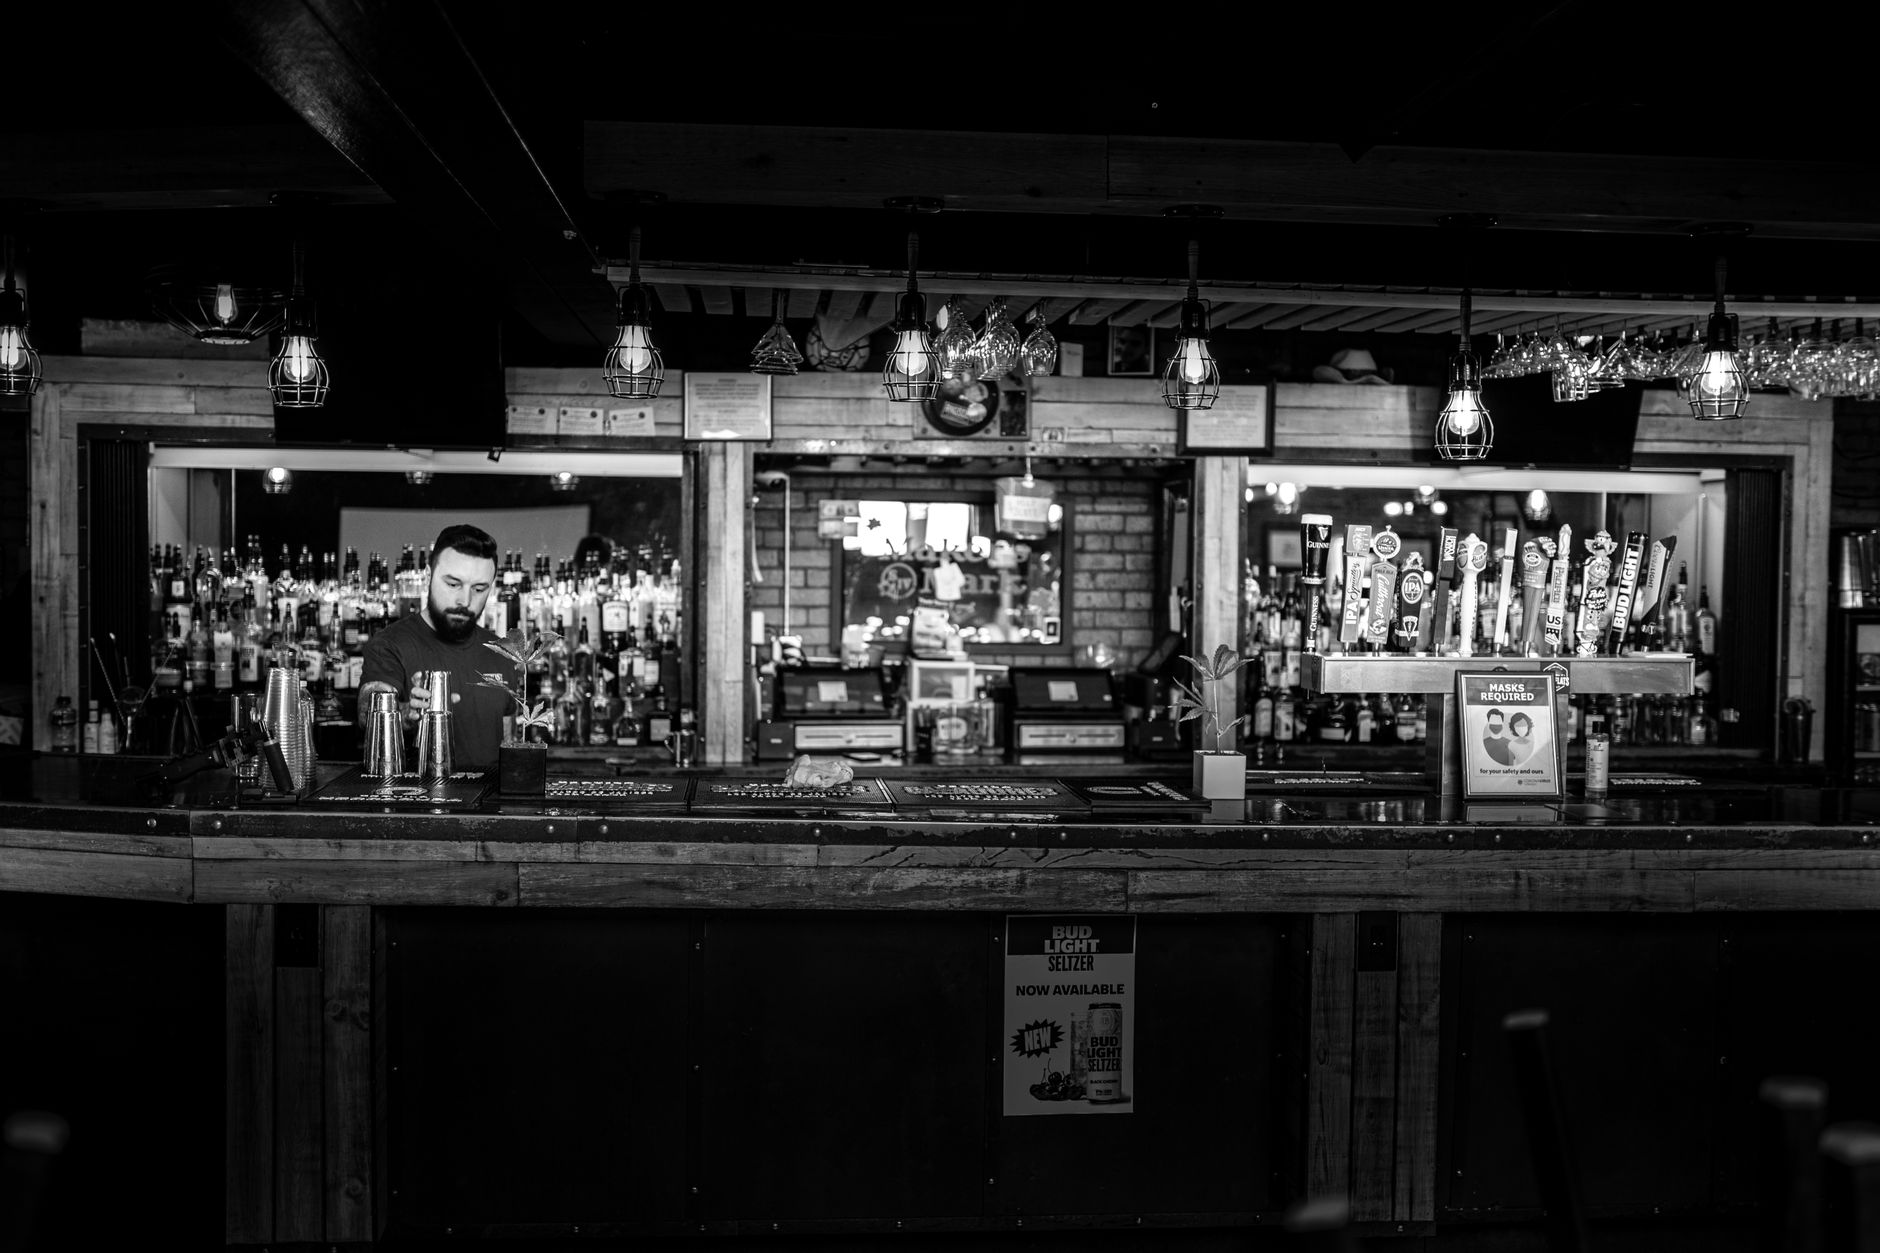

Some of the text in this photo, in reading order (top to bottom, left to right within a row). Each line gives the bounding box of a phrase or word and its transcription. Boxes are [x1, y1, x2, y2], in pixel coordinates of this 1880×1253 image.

[1307, 541, 1330, 549] GUINNE
[1347, 562, 1361, 600] Squatters
[1648, 569, 1656, 588] LIGHT
[1405, 582, 1421, 592] IPA
[1613, 547, 1640, 629] BUD LIGHT
[1309, 595, 1319, 632] GUINNESS
[1345, 601, 1359, 625] IPA
[1547, 615, 1562, 626] US
[1489, 683, 1525, 692] MASKS
[1480, 692, 1535, 702] REQUIRED
[1052, 925, 1093, 940] BUD
[1043, 938, 1100, 954] LIGHT
[1048, 955, 1094, 971] SELTZER
[1016, 984, 1125, 996] NOW AVAILABLE
[1024, 1024, 1052, 1053] NEW
[1090, 1036, 1118, 1047] BUD
[1087, 1047, 1121, 1058] LIGHT
[1088, 1058, 1121, 1072] SELTZER
